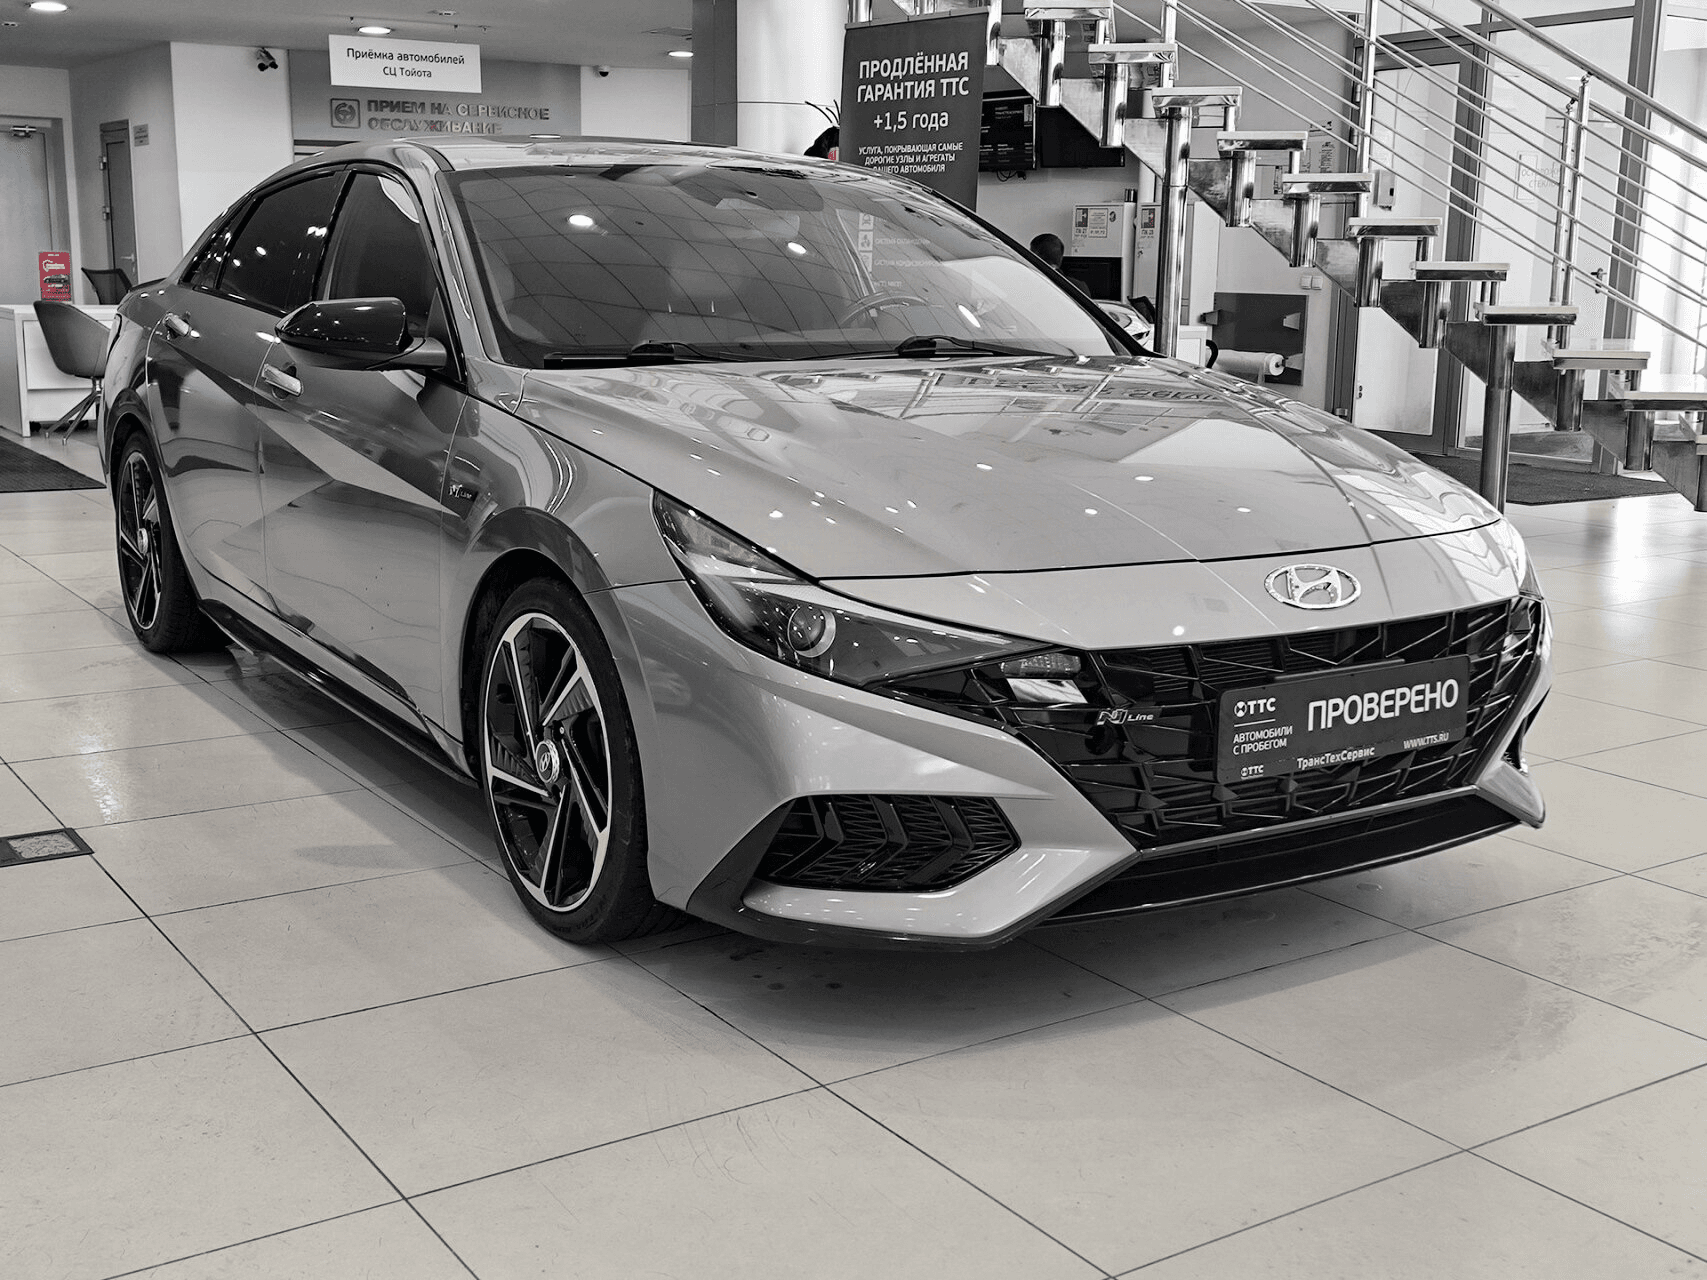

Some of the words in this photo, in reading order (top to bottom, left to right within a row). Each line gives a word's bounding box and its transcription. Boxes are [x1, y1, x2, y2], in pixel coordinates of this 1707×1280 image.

[346, 47, 394, 61] Приёмка
[397, 53, 465, 65] автомобилей
[382, 66, 397, 77] СЦ
[400, 68, 432, 78] Тойота
[859, 51, 969, 80] ПРОДЛЁННАЯ
[857, 79, 936, 103] ГАРАНТИЯ
[940, 76, 970, 97] ТТС
[367, 100, 426, 114] ПРИЕМ
[430, 102, 452, 115] НА
[455, 103, 550, 120] СЕРВИСНОЕ
[367, 117, 502, 134] ОБСЛУЖИВАНИЕ
[873, 111, 908, 133] +1,5
[911, 111, 949, 132] года
[859, 146, 883, 156] УСЛУГА,
[884, 143, 937, 154] ПОКРЫВАЮЩАЯ
[937, 142, 963, 152] САМЫЕ
[865, 156, 895, 166] ДОРОГИЕ
[895, 154, 914, 164] УЗЛЫ
[915, 154, 921, 163] И
[921, 152, 956, 162] АГРЕГАТЫ
[900, 163, 946, 174] АВТОМОБИЛЯ
[1247, 697, 1277, 714] ТТС
[1307, 678, 1460, 731] ПРОВЕРЕНО
[1233, 725, 1293, 744] АВТОМОБИЛИ
[1233, 746, 1240, 755] С
[1241, 738, 1288, 753] ПРОБЕГОМ
[1296, 747, 1375, 770] ТрансТехСервис
[1248, 764, 1265, 775] ТТС
